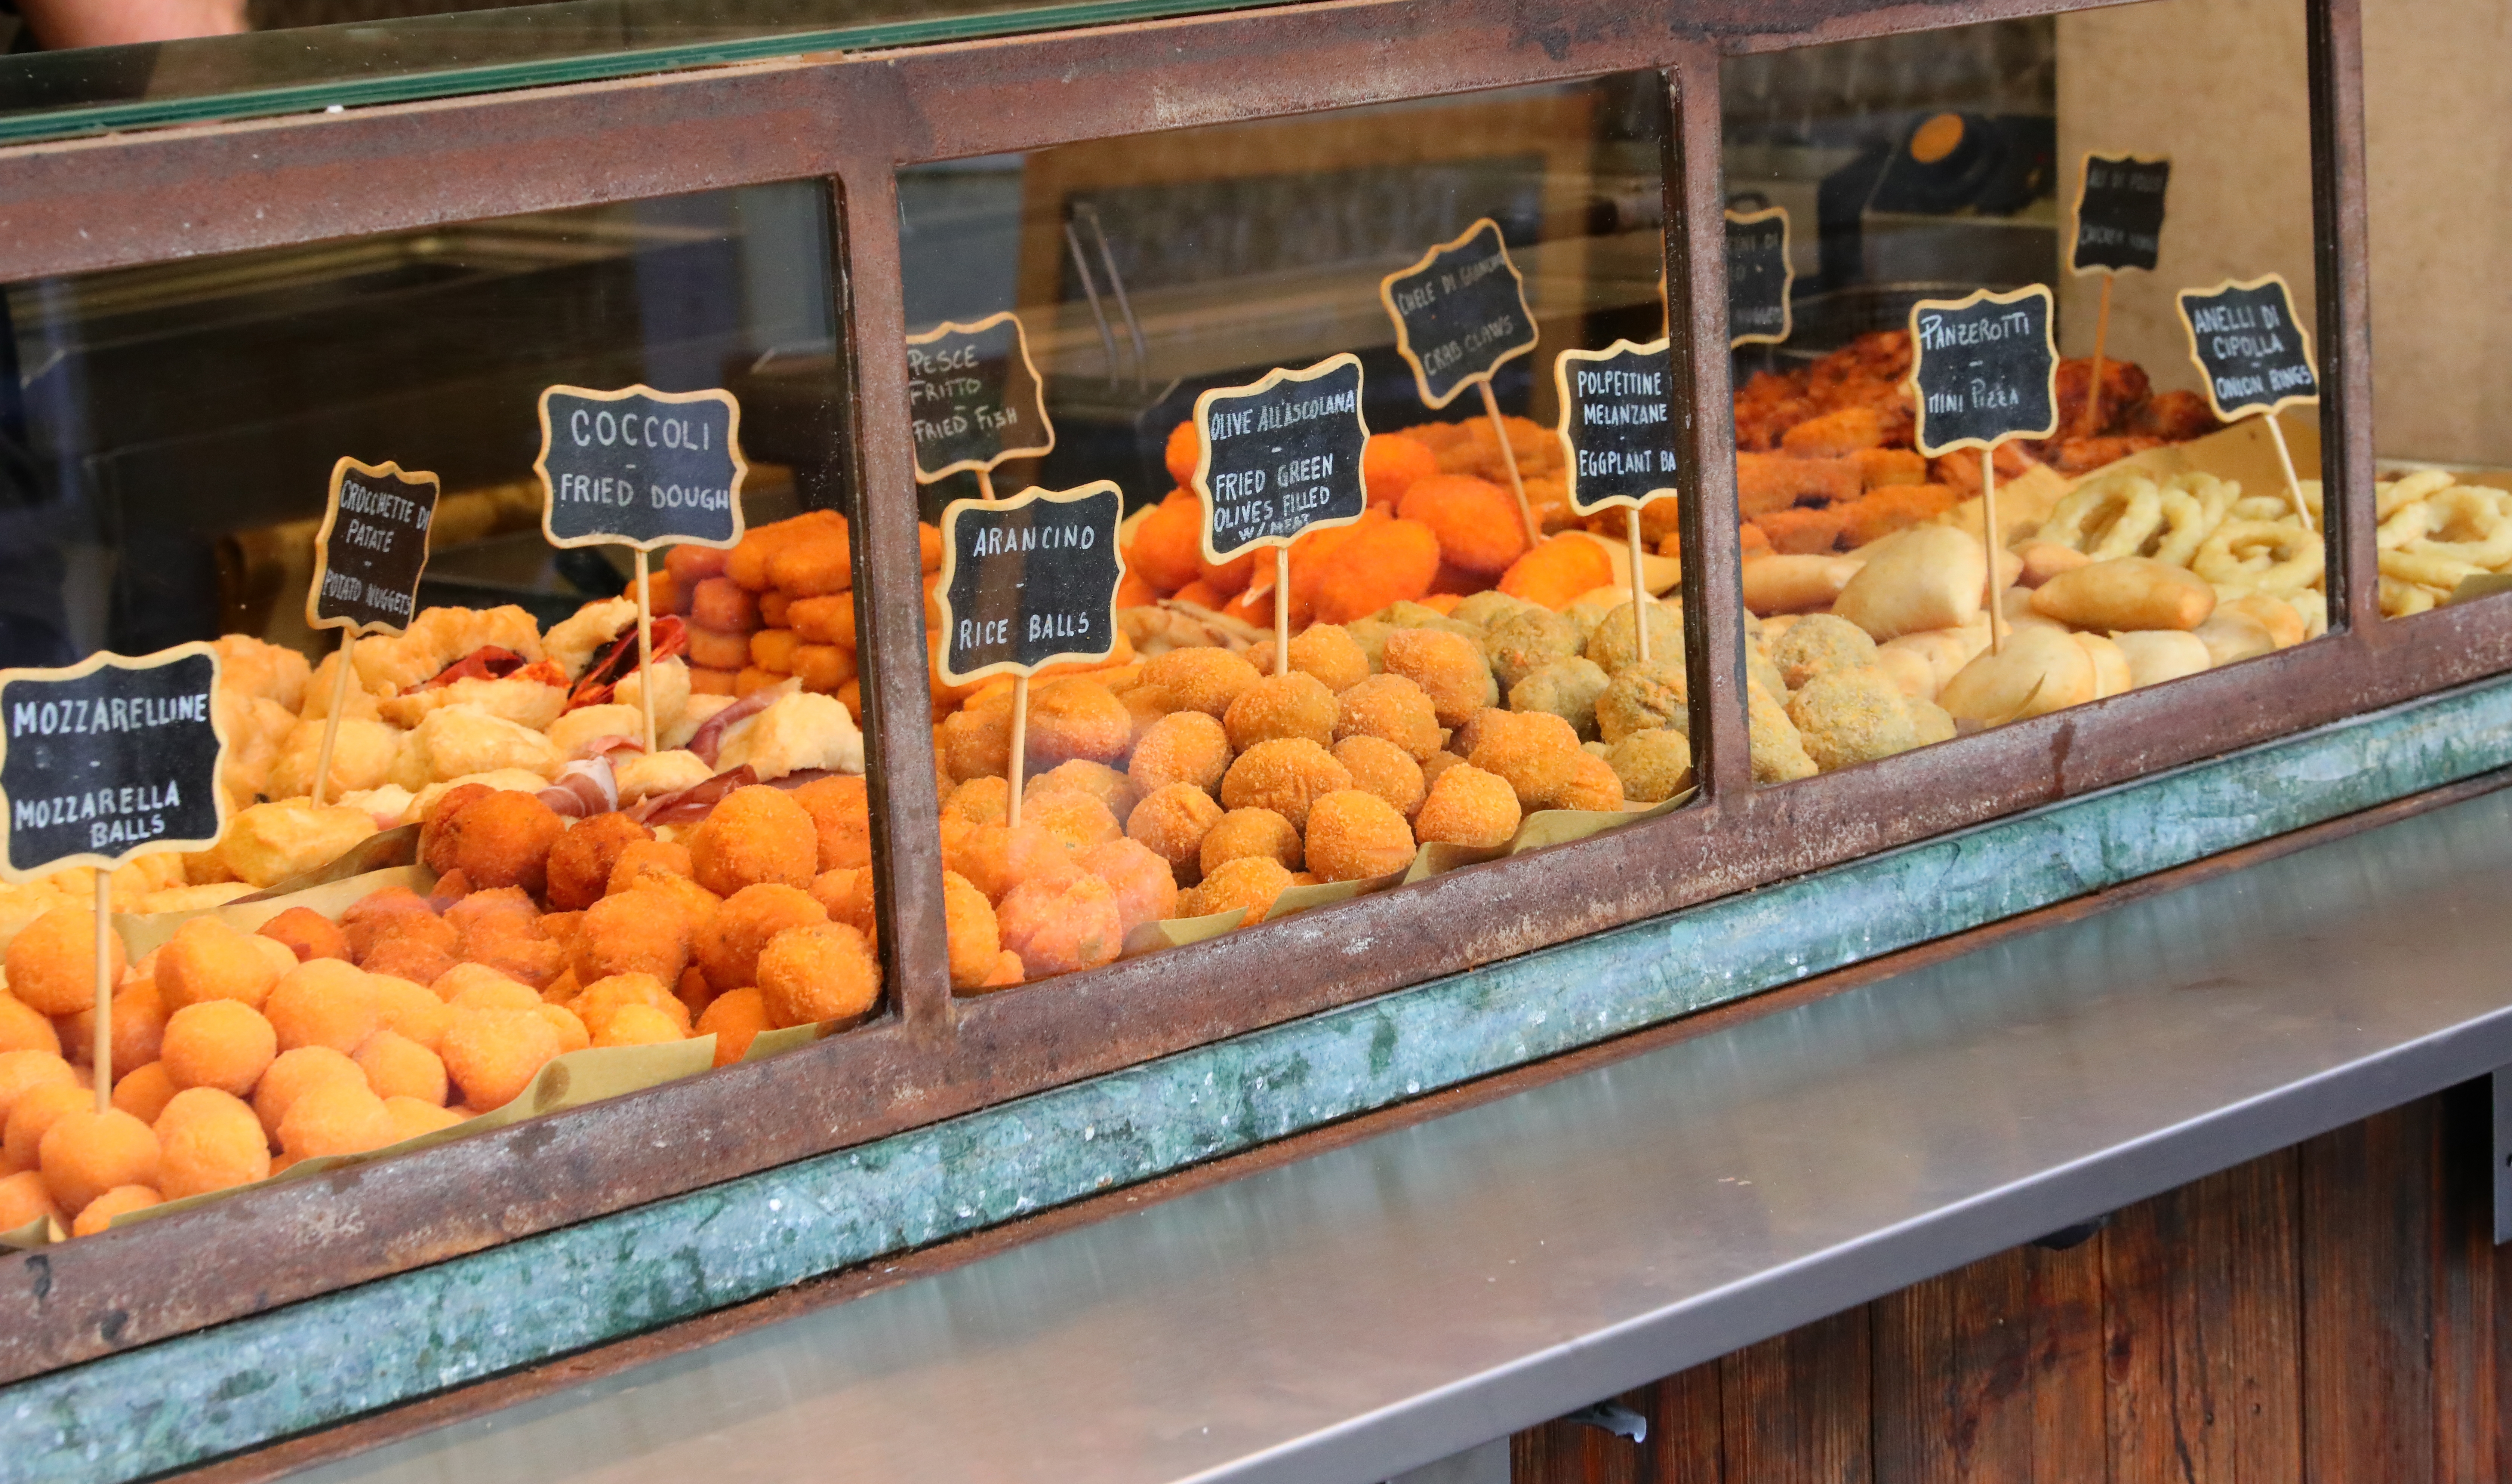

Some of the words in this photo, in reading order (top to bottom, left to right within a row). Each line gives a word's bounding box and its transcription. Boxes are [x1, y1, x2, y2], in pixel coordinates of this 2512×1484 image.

[1919, 311, 2029, 350] PANZEROTTI
[2194, 305, 2256, 334] ANELLI
[2260, 304, 2281, 330] DI
[907, 345, 979, 375] PESCE
[1423, 340, 1463, 376] CRAB
[1464, 314, 1514, 352] CLAWS
[2213, 333, 2285, 360] CIPOLLA
[909, 377, 981, 405] FRITTO
[1577, 370, 1662, 397] POLPETTINE
[2216, 375, 2264, 400] ONION
[571, 410, 709, 450] COCCOLI
[912, 416, 967, 443] FRIED
[975, 404, 1018, 430] FISH
[1211, 409, 1253, 441] OLIVE
[1584, 403, 1667, 426] MELANZANE
[1216, 469, 1266, 502] FRIED
[1277, 453, 1333, 487] GREEN
[1579, 449, 1652, 477] EGGPLANT
[340, 480, 415, 523] CROCCHETTE
[561, 473, 634, 507] FRIED
[651, 484, 729, 511] DOUGH
[1214, 500, 1273, 533] OLIVES
[1283, 486, 1330, 517] FILLED
[345, 519, 394, 552] PATATE
[973, 525, 1095, 557] ARANCINO
[959, 619, 1009, 651] RICE
[1029, 612, 1089, 643] BALLS
[13, 693, 208, 738] MOZZARELLINE
[16, 780, 180, 831] MOZZARELLA
[90, 814, 165, 849] BALLS
